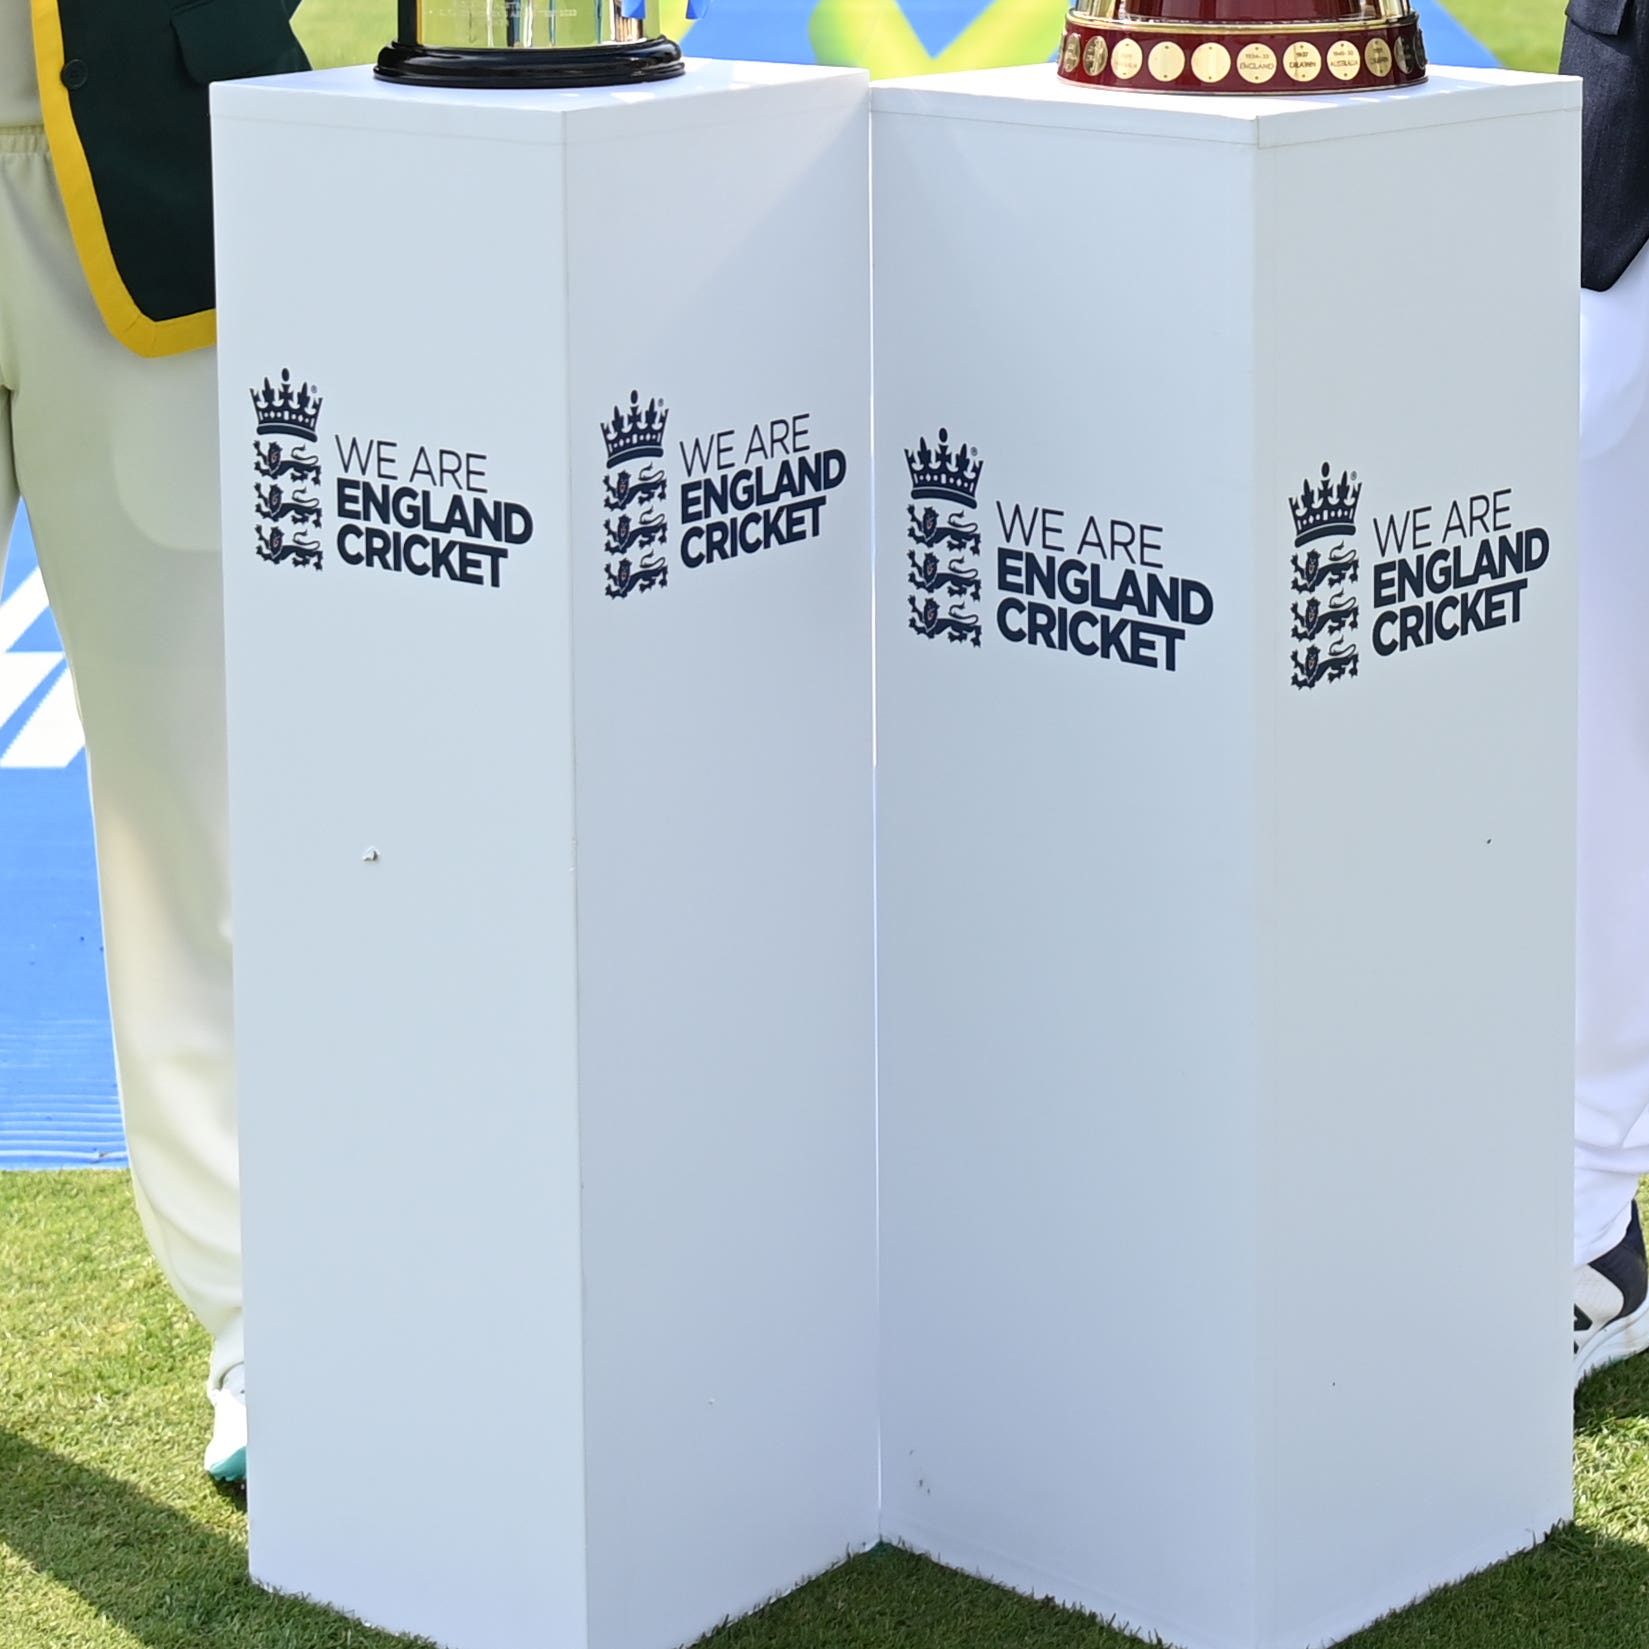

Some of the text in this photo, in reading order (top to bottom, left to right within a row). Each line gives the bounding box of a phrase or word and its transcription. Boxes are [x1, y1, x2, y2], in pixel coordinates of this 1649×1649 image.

[1239, 62, 1274, 70] ENGLAND
[335, 434, 488, 494] WE ARE
[679, 413, 811, 477] WE ARE
[336, 477, 534, 545] ENGLAND
[680, 448, 847, 524] ENGLAND
[336, 523, 509, 588] CRICKET
[680, 495, 827, 569] CRICKET
[996, 500, 1163, 569] WE ARE
[1372, 488, 1512, 558] WE ARE
[997, 547, 1214, 627] ENGLAND
[1373, 527, 1550, 609] ENGLAND
[996, 596, 1186, 672] CRICKET
[1372, 579, 1528, 657] CRICKET
